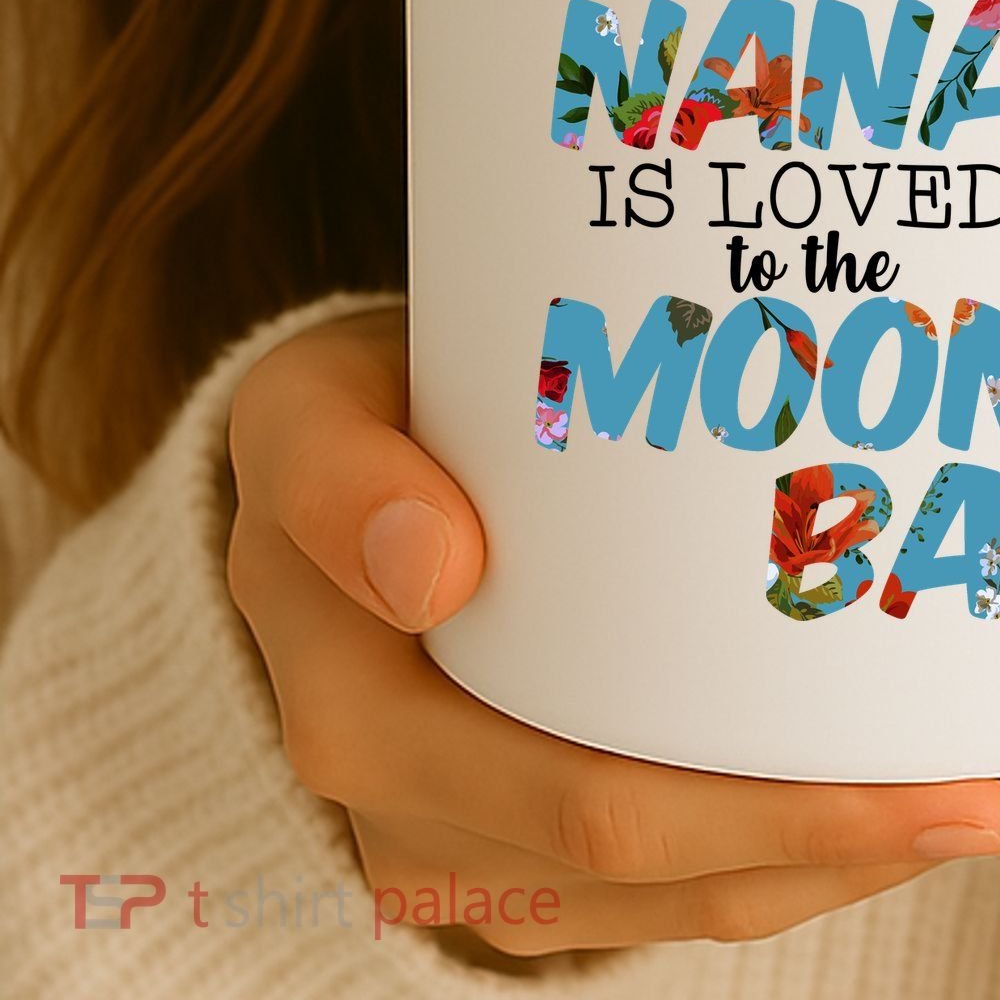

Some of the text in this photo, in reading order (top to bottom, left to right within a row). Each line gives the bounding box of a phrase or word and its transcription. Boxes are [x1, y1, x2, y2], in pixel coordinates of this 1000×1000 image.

[588, 158, 673, 229] IS
[726, 230, 900, 293] to the
